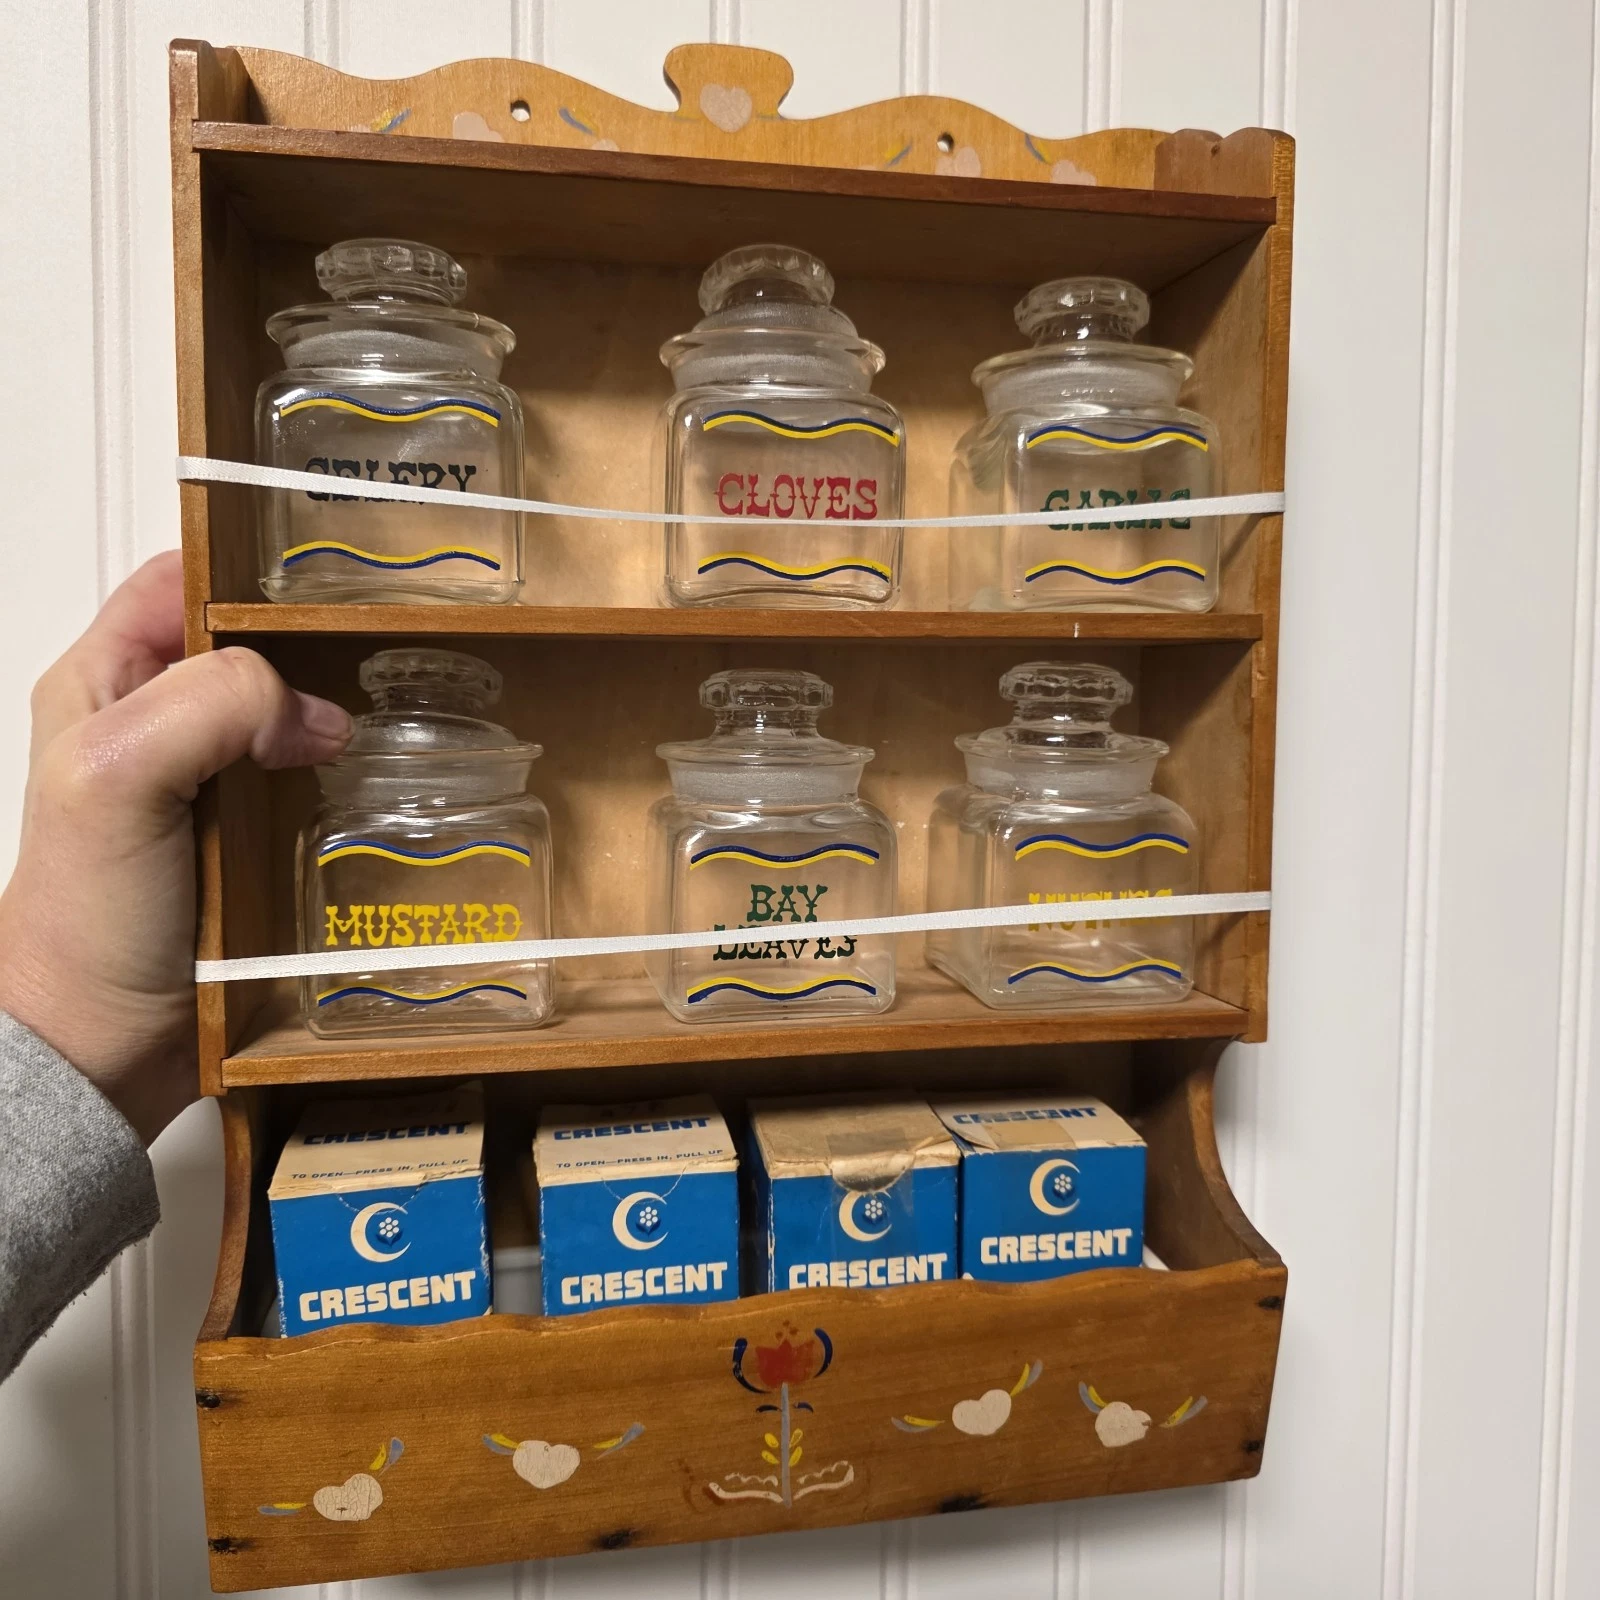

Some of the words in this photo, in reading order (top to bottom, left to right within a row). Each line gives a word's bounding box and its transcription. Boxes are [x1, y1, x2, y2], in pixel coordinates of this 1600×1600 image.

[714, 472, 878, 520] CLOVES
[746, 884, 828, 923] BAY
[324, 903, 524, 947] MUSTARD
[304, 1123, 470, 1145] CRESCENT
[554, 1117, 710, 1140] CRESCENT
[418, 1161, 447, 1169] PULL
[676, 1151, 703, 1159] PULL
[980, 1227, 1133, 1265] CRESCENT
[561, 1261, 728, 1306] CRESCENT
[788, 1252, 948, 1291] CRESCENT
[299, 1270, 476, 1322] CRESCENT
